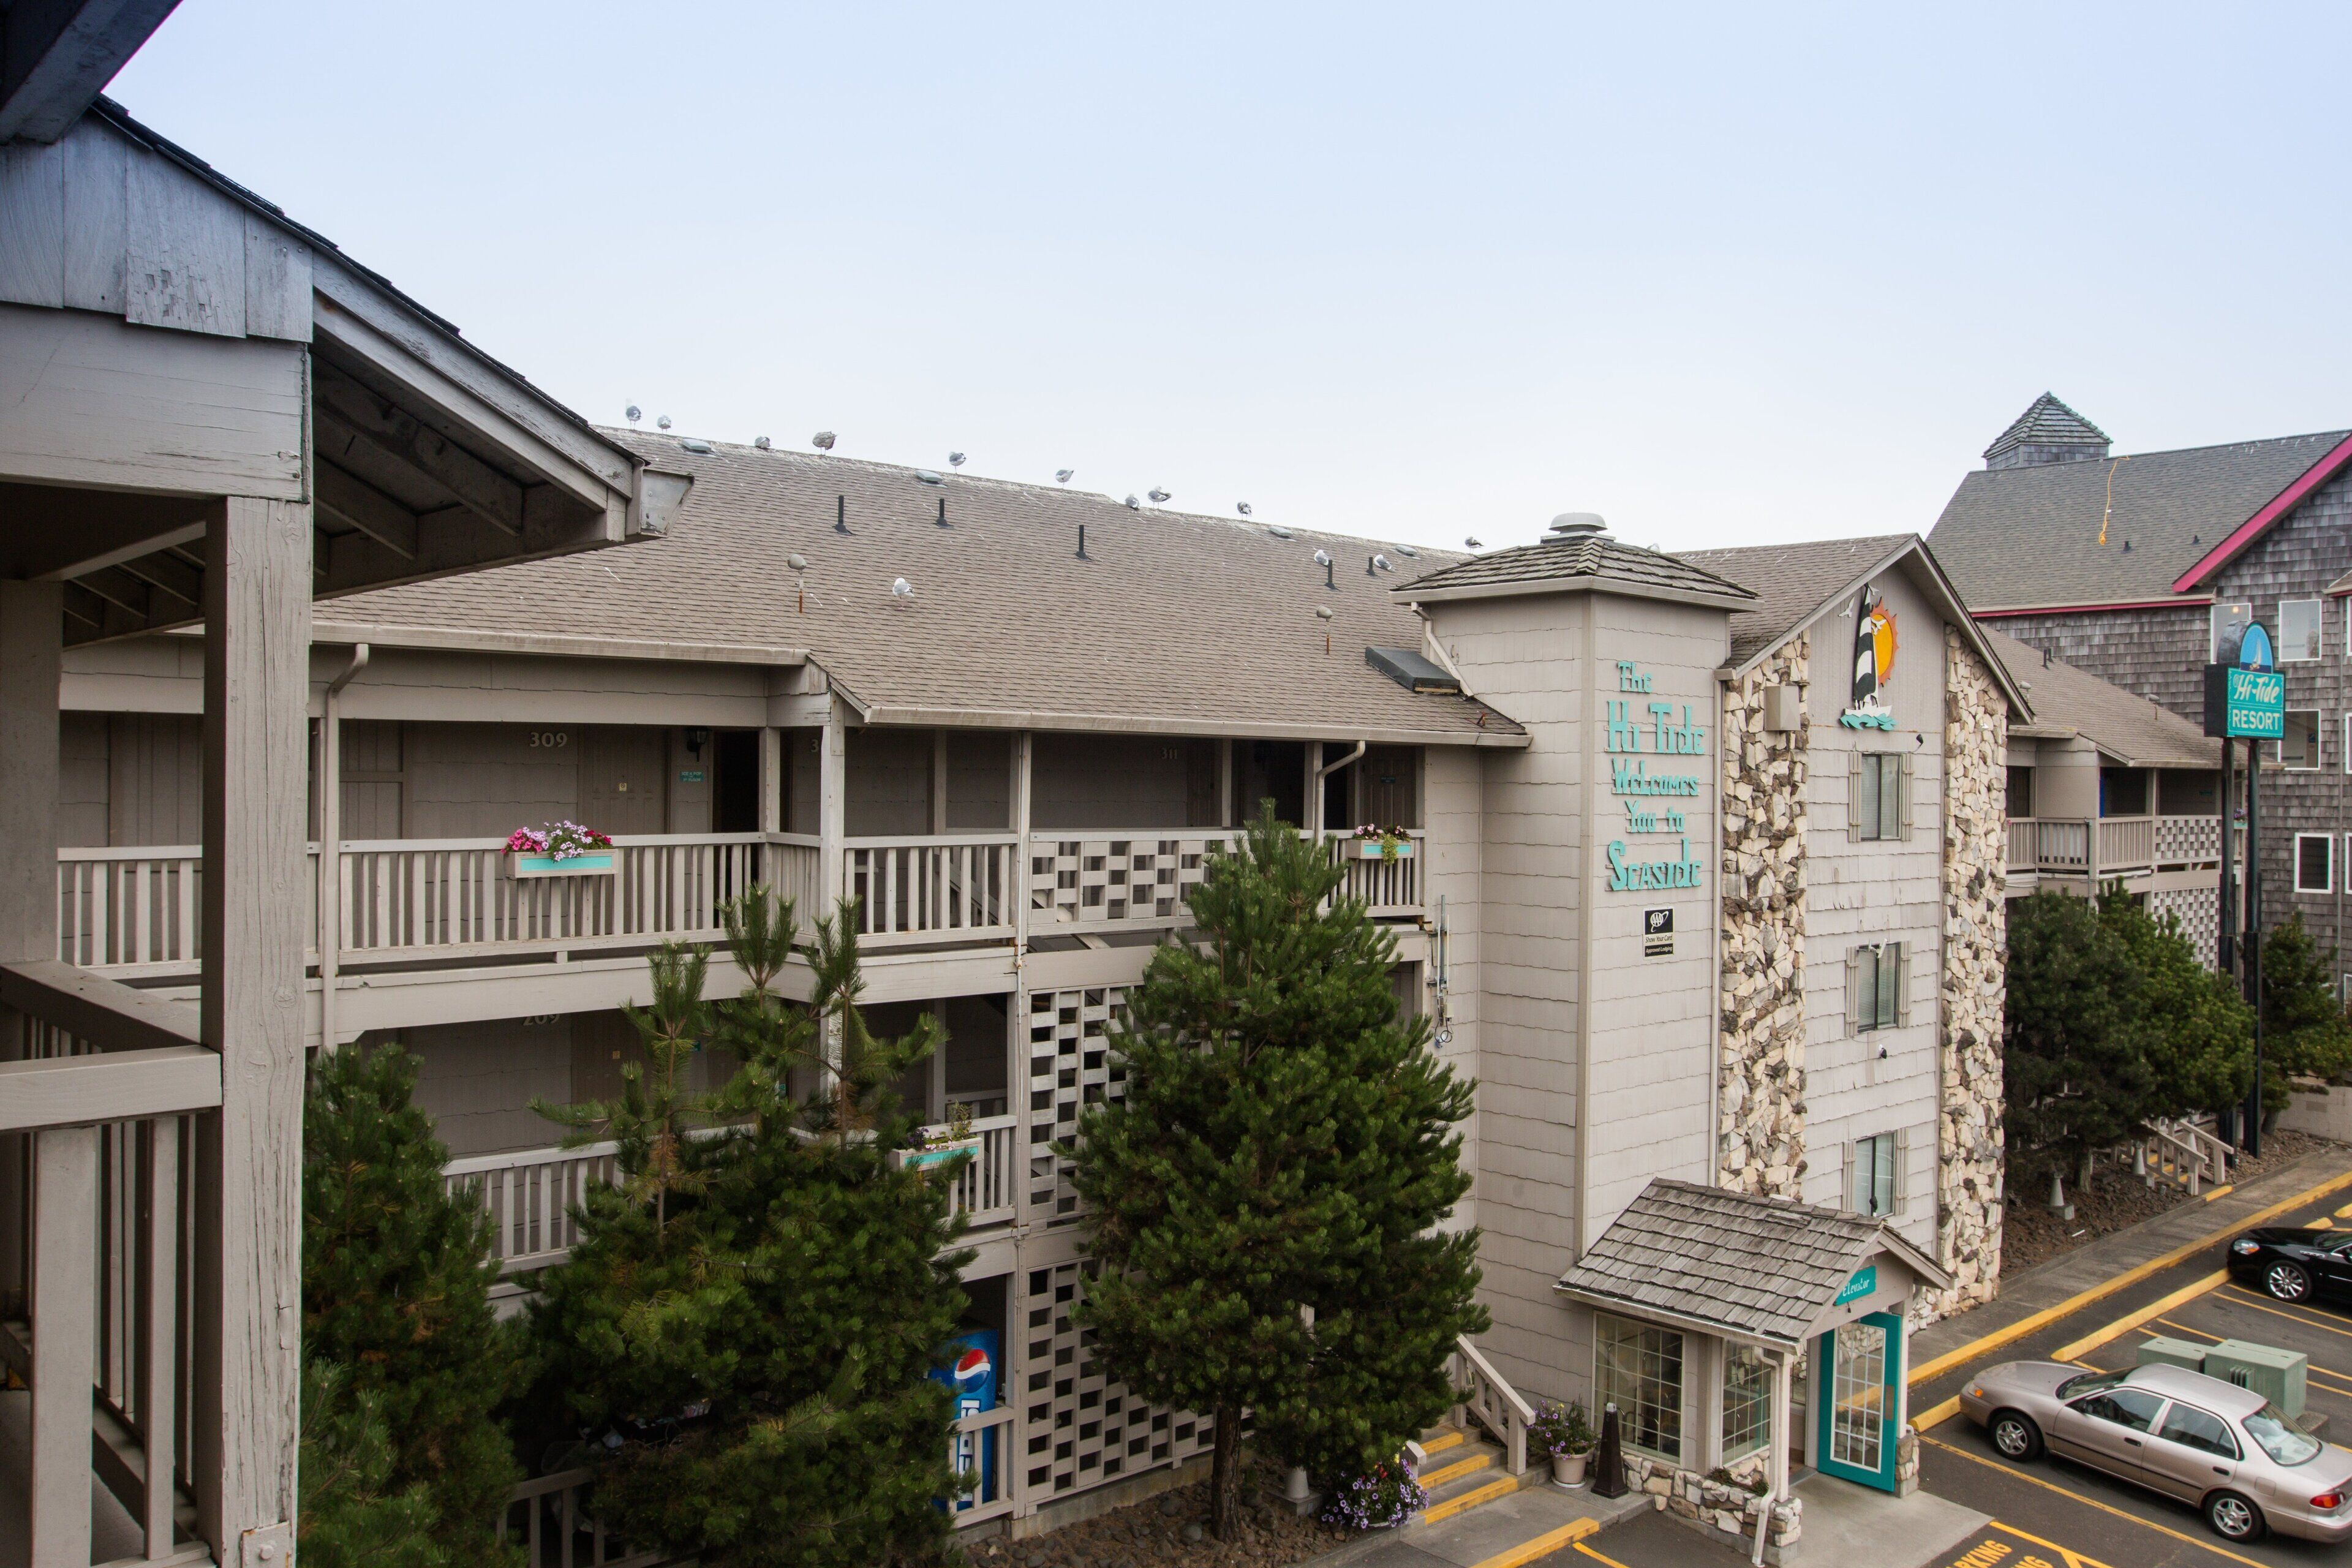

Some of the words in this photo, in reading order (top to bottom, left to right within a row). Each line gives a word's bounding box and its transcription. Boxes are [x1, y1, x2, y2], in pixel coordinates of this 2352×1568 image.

[1617, 661, 1653, 693] The
[2233, 674, 2280, 704] Hi-Tide
[1607, 701, 1642, 753] Hi
[1648, 703, 1705, 755] Tide
[2232, 709, 2280, 730] RESORT
[530, 731, 567, 748] 309
[1161, 747, 1177, 760] 311
[1611, 758, 1698, 795] Welcomes
[1625, 800, 1656, 833] You
[1666, 807, 1684, 832] to
[1607, 838, 1703, 891] Seaside
[1842, 1278, 1869, 1297] Elevator
